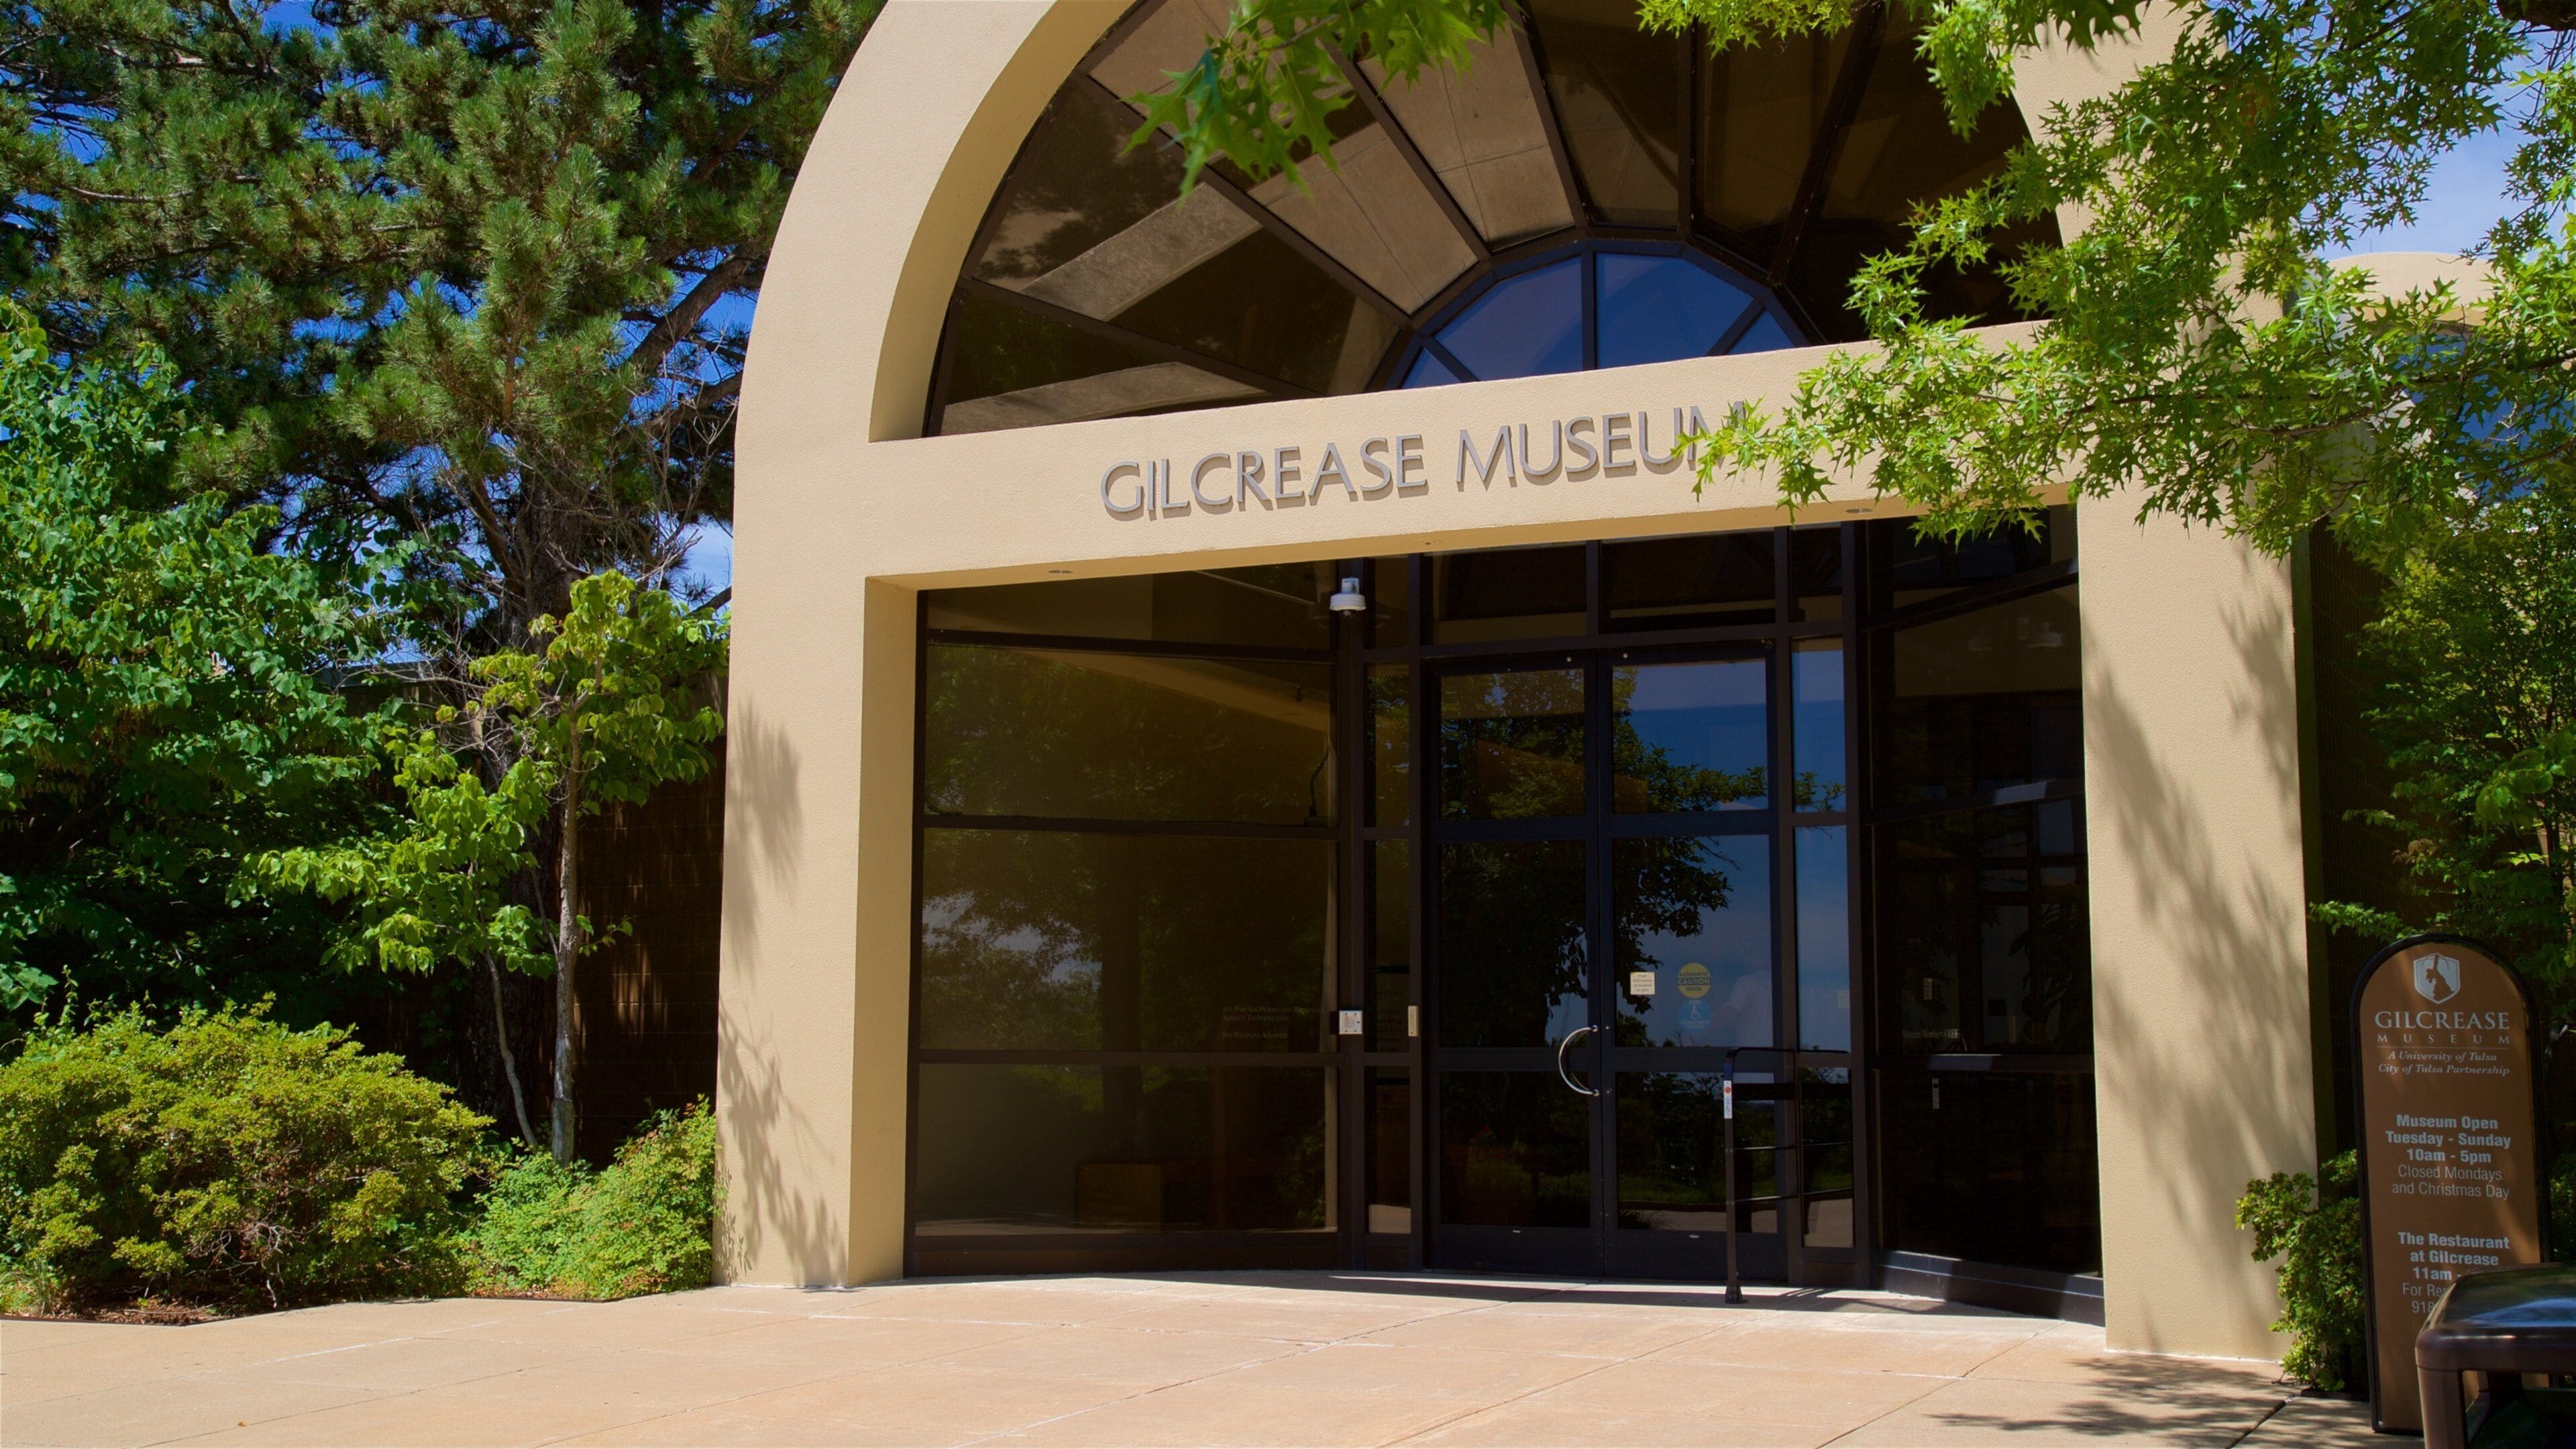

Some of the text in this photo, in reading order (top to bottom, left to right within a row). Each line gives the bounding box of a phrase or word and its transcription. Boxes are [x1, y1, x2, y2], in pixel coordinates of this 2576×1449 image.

[1100, 433, 1428, 513] GILCREASE
[2374, 1010, 2510, 1030] GILCREASE
[2377, 1034, 2510, 1044] MUSEUM
[2387, 1051, 2498, 1063] A University of Tulsa
[2378, 1064, 2510, 1077] City of Tulsa Partnership
[2396, 1114, 2498, 1131] Museum Open
[2385, 1131, 2443, 1147] Tuesday
[2458, 1132, 2512, 1149] Sunday
[2407, 1148, 2445, 1161] 10am
[2460, 1150, 2491, 1165] 5pm
[2398, 1165, 2502, 1183] Closed Mondays
[2392, 1181, 2510, 1200] and Christmas Day
[2398, 1232, 2510, 1249] The Restaurant
[2410, 1250, 2499, 1266] at Gilcrease
[2412, 1267, 2452, 1281] 11am
[2402, 1283, 2422, 1296] For
